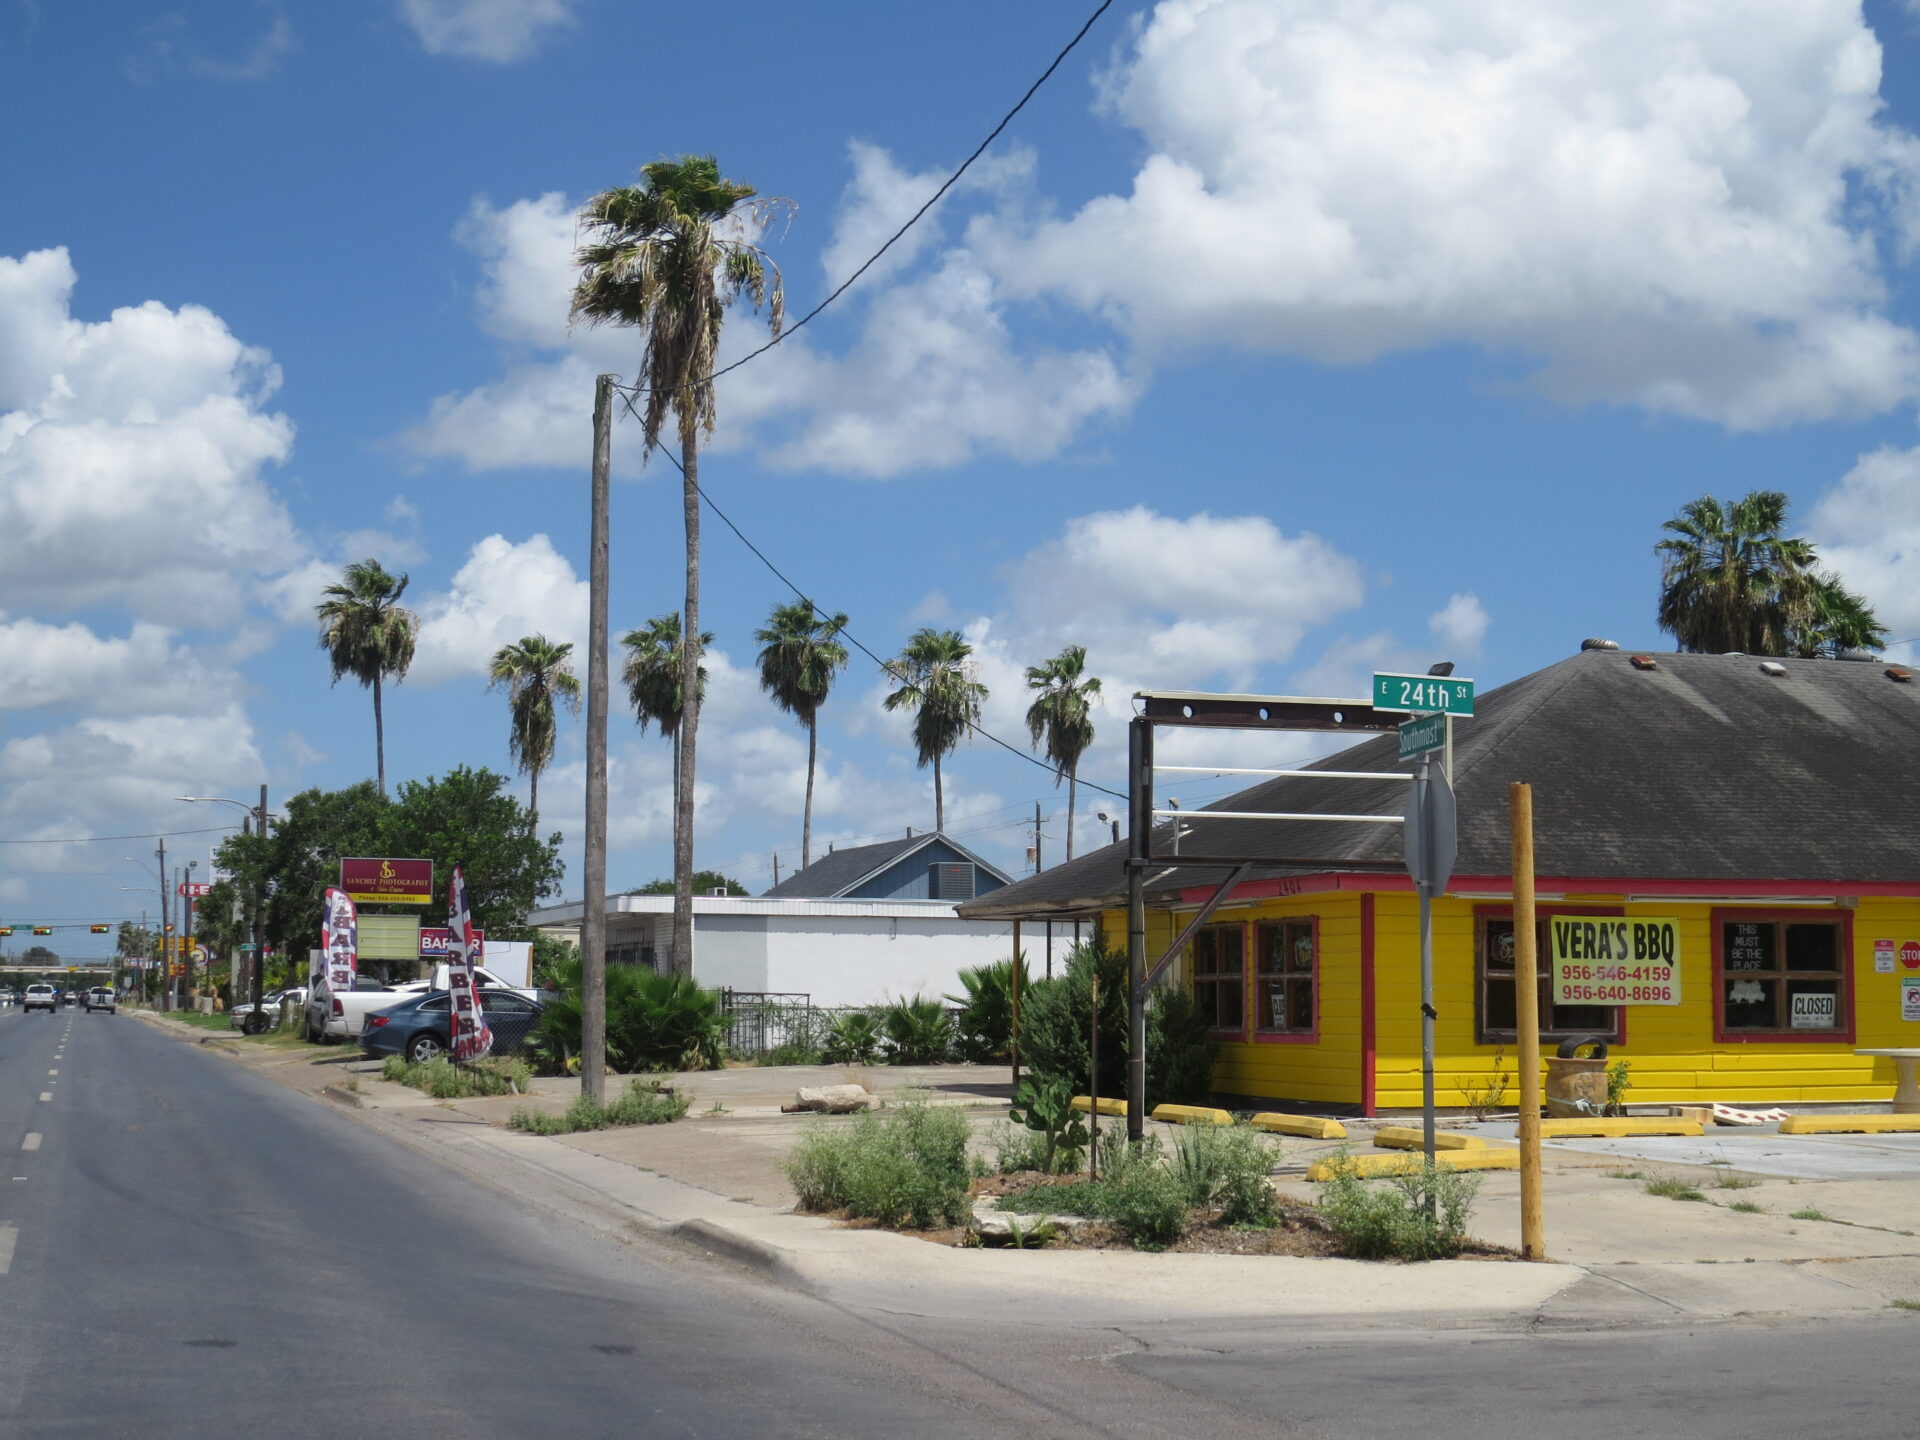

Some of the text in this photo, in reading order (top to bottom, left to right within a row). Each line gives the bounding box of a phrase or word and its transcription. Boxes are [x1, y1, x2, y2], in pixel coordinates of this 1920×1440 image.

[1382, 681, 1467, 708] E 24th St
[1399, 720, 1438, 753] Southmost
[379, 878, 429, 886] PHOTOGRAPHY
[1736, 924, 1757, 934] THIS
[1555, 922, 1674, 967] VERA'S BBQ
[1735, 936, 1760, 947] MUST
[1732, 948, 1763, 959] BE THE
[1561, 965, 1671, 981] 956-546-4159
[1562, 985, 1671, 1001] 956-640-8696
[1794, 997, 1833, 1015] CLOSED
